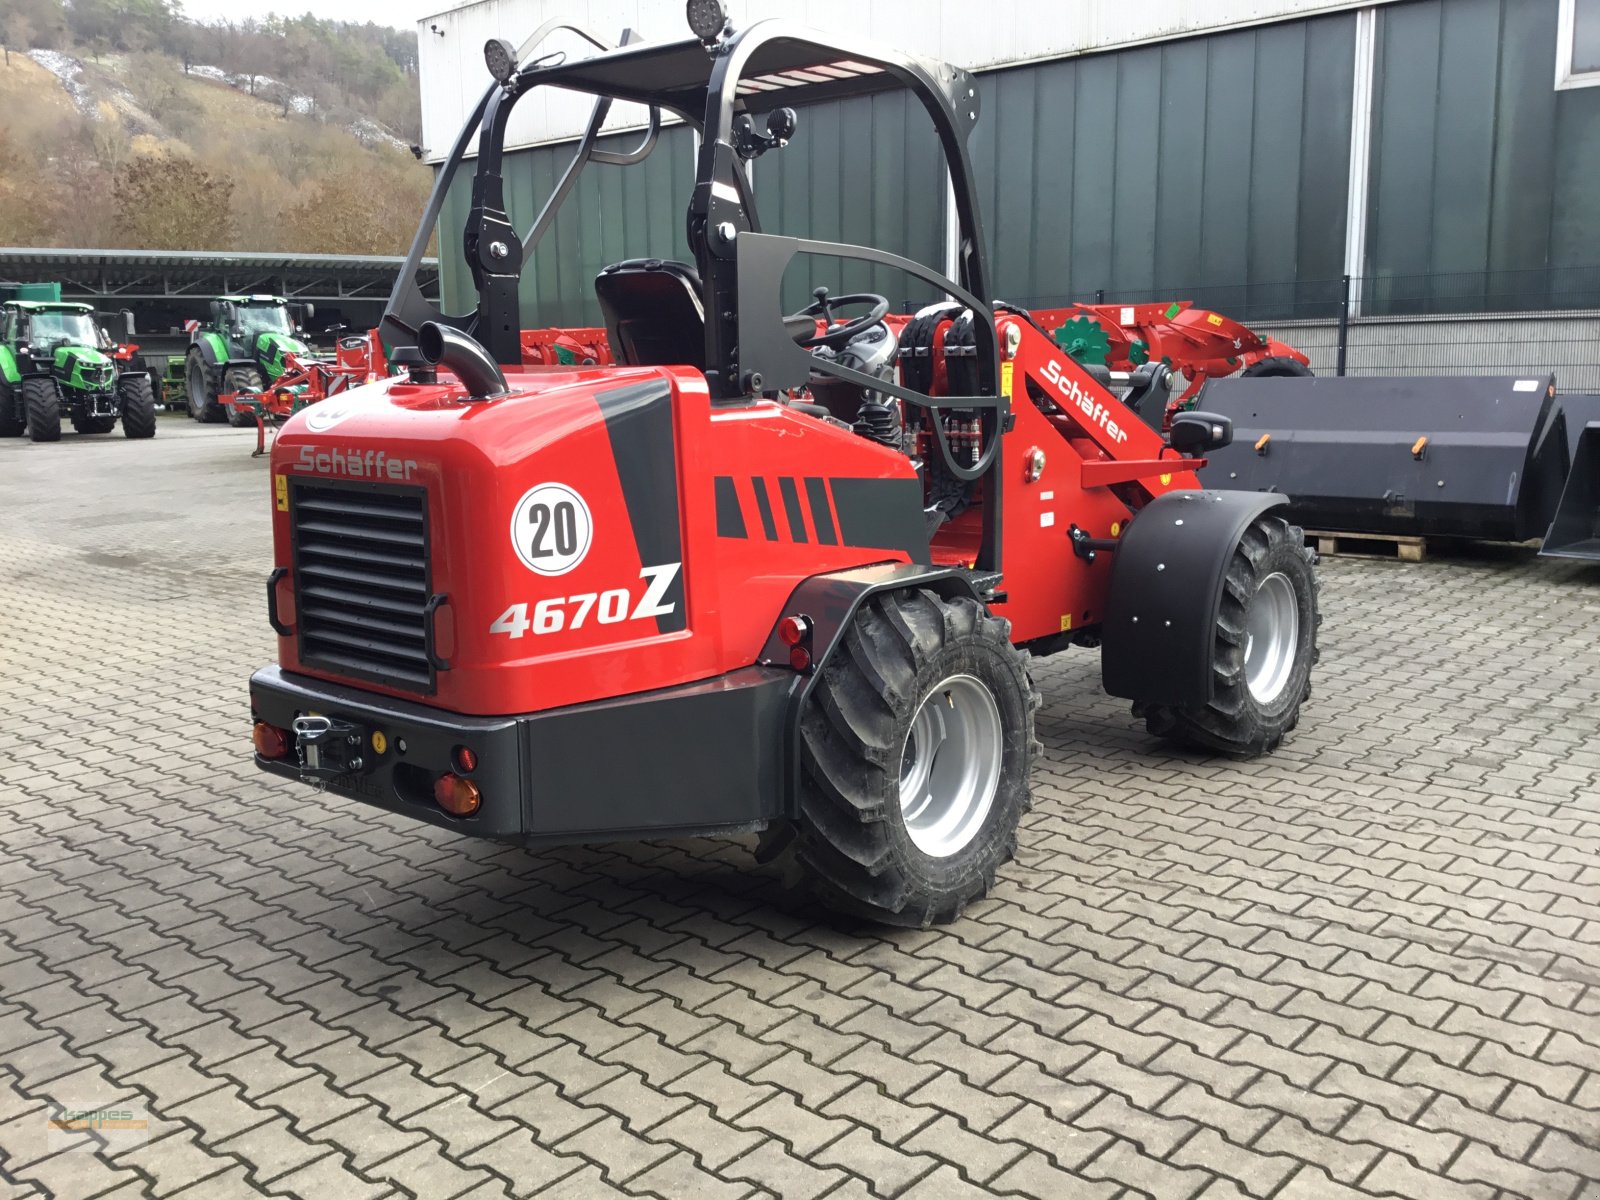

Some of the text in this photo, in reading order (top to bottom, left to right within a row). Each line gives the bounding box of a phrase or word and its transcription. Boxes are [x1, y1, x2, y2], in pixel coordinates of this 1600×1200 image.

[1040, 359, 1128, 444] Schäffer
[293, 446, 418, 480] Schäffer
[528, 501, 576, 558] 20
[489, 562, 681, 639] 4670Z
